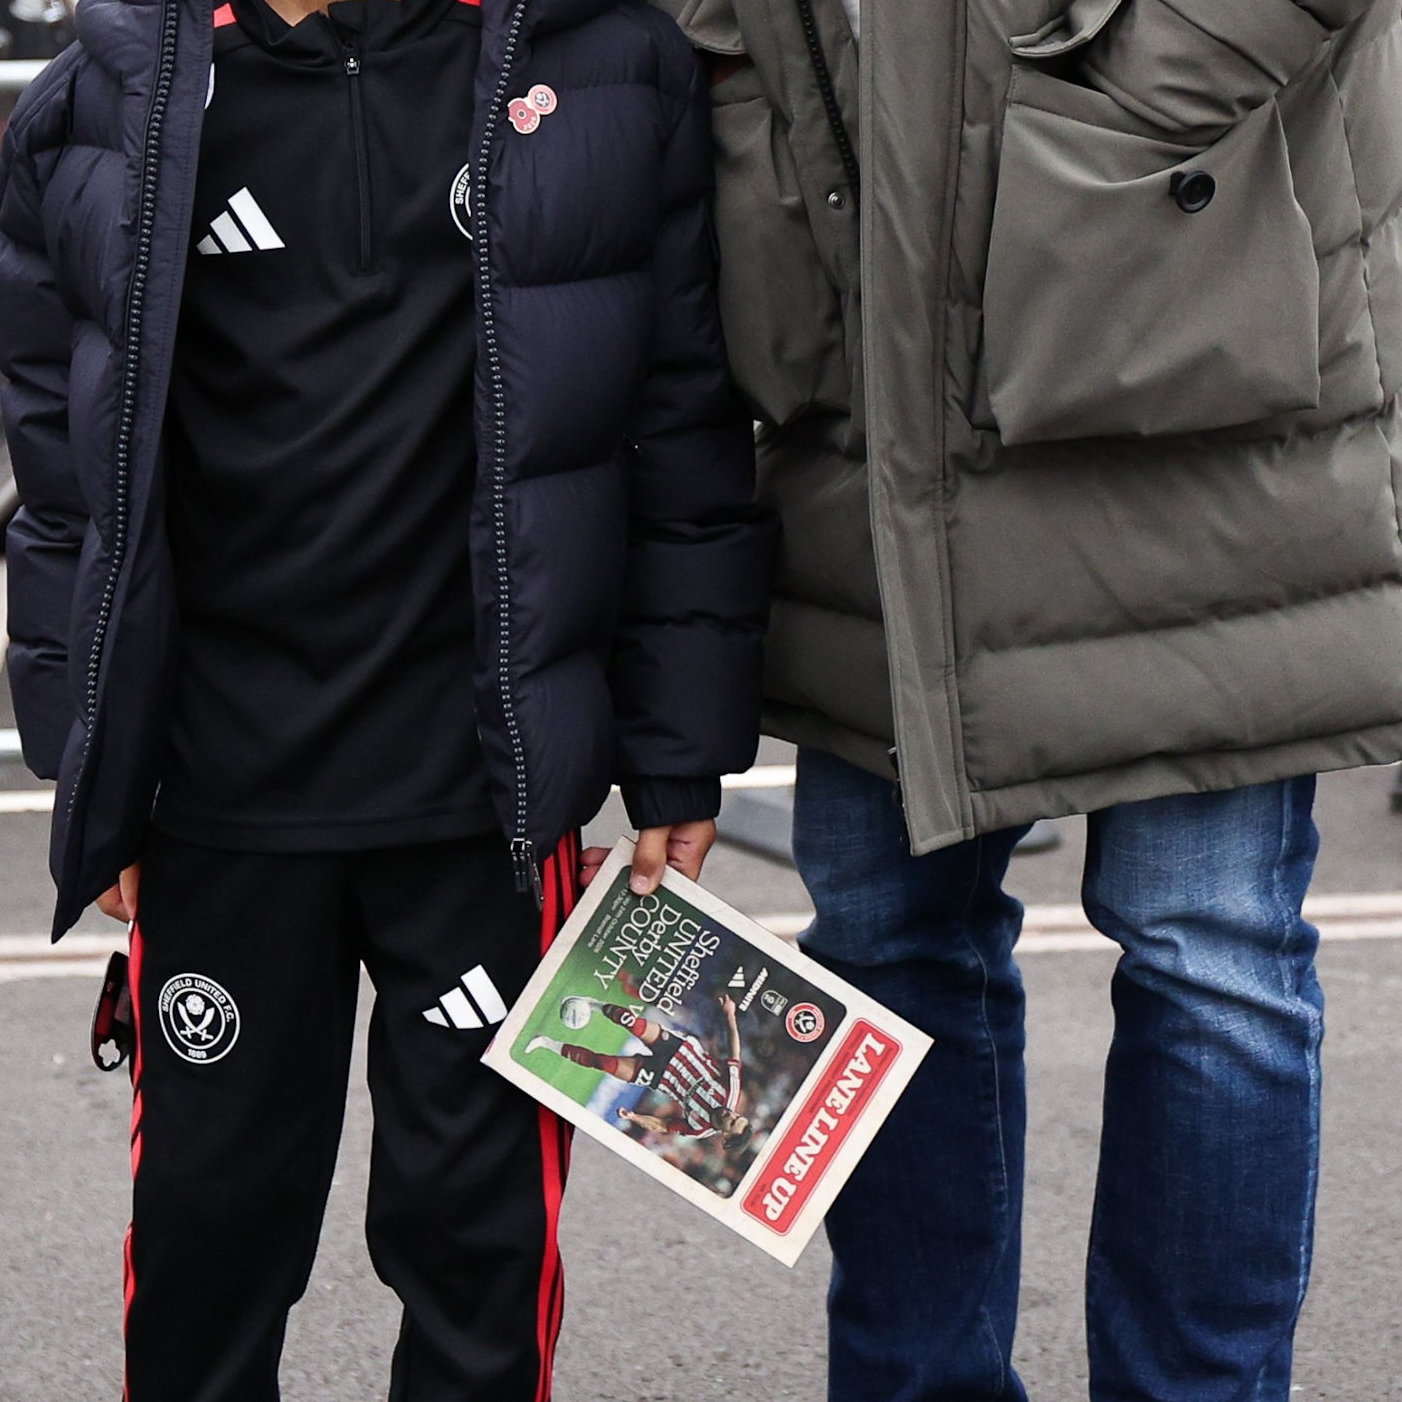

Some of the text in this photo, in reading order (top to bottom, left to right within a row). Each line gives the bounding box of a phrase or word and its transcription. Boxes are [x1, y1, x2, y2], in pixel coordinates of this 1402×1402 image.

[594, 894, 660, 990] COUNTY
[633, 904, 682, 965] Derby
[161, 978, 235, 1023] SHEFFIELD UNITED F.C.
[620, 919, 701, 1026] UNITED vs
[656, 930, 720, 1017] Sheffield
[739, 967, 768, 1011] MIDNITE
[825, 1033, 885, 1114] LANE
[783, 1107, 838, 1181] LINE
[762, 1177, 796, 1220] UP
